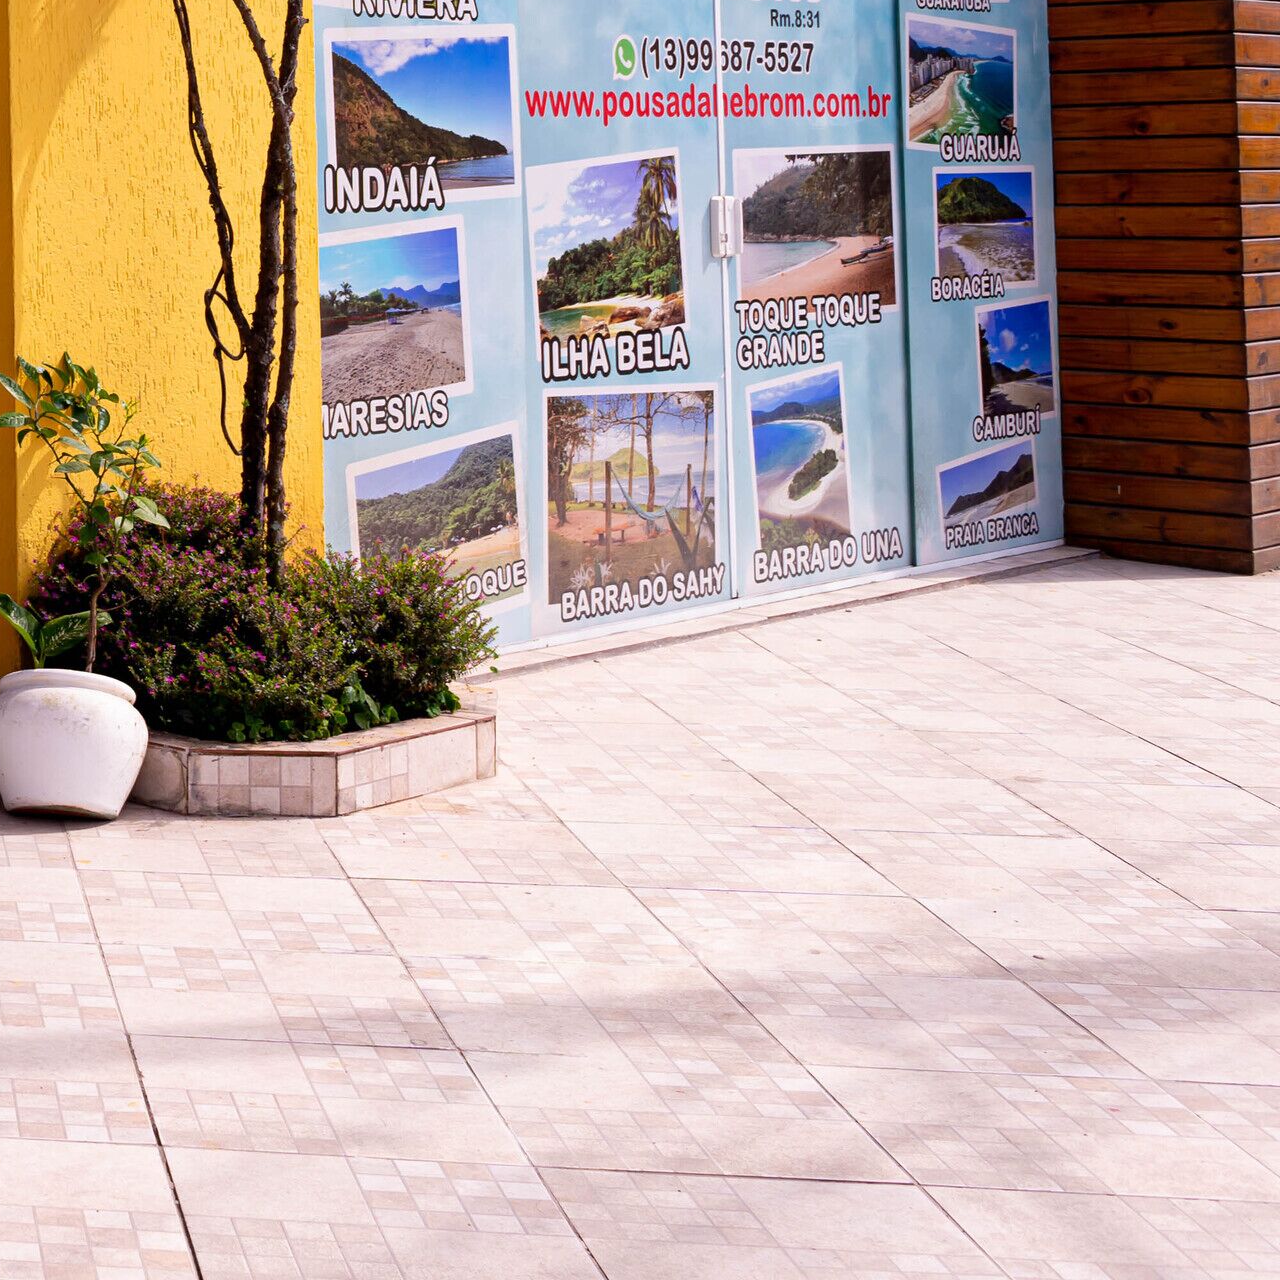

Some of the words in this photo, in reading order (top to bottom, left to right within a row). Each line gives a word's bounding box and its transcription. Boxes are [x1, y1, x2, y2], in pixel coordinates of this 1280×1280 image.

[770, 9, 820, 28] Rm.8:31
[940, 128, 1021, 162] GUARUJÁ
[324, 156, 445, 213] INDAIÁ
[931, 270, 1004, 302] BORACÉIA
[734, 298, 808, 336] TOQUE
[812, 291, 881, 327] TOQUE
[541, 334, 610, 382] ILHA
[616, 327, 690, 375] BELA
[736, 331, 825, 370] GRANDE
[973, 404, 1041, 442] CAMBURÍ
[945, 521, 985, 549] PRAIA
[987, 511, 1039, 543] BRANCA
[753, 549, 825, 584] BARRA
[828, 537, 859, 569] DO
[860, 527, 904, 563] UNA
[560, 582, 633, 623] BARRA
[637, 577, 670, 609] DO
[672, 562, 726, 601] SAHY
